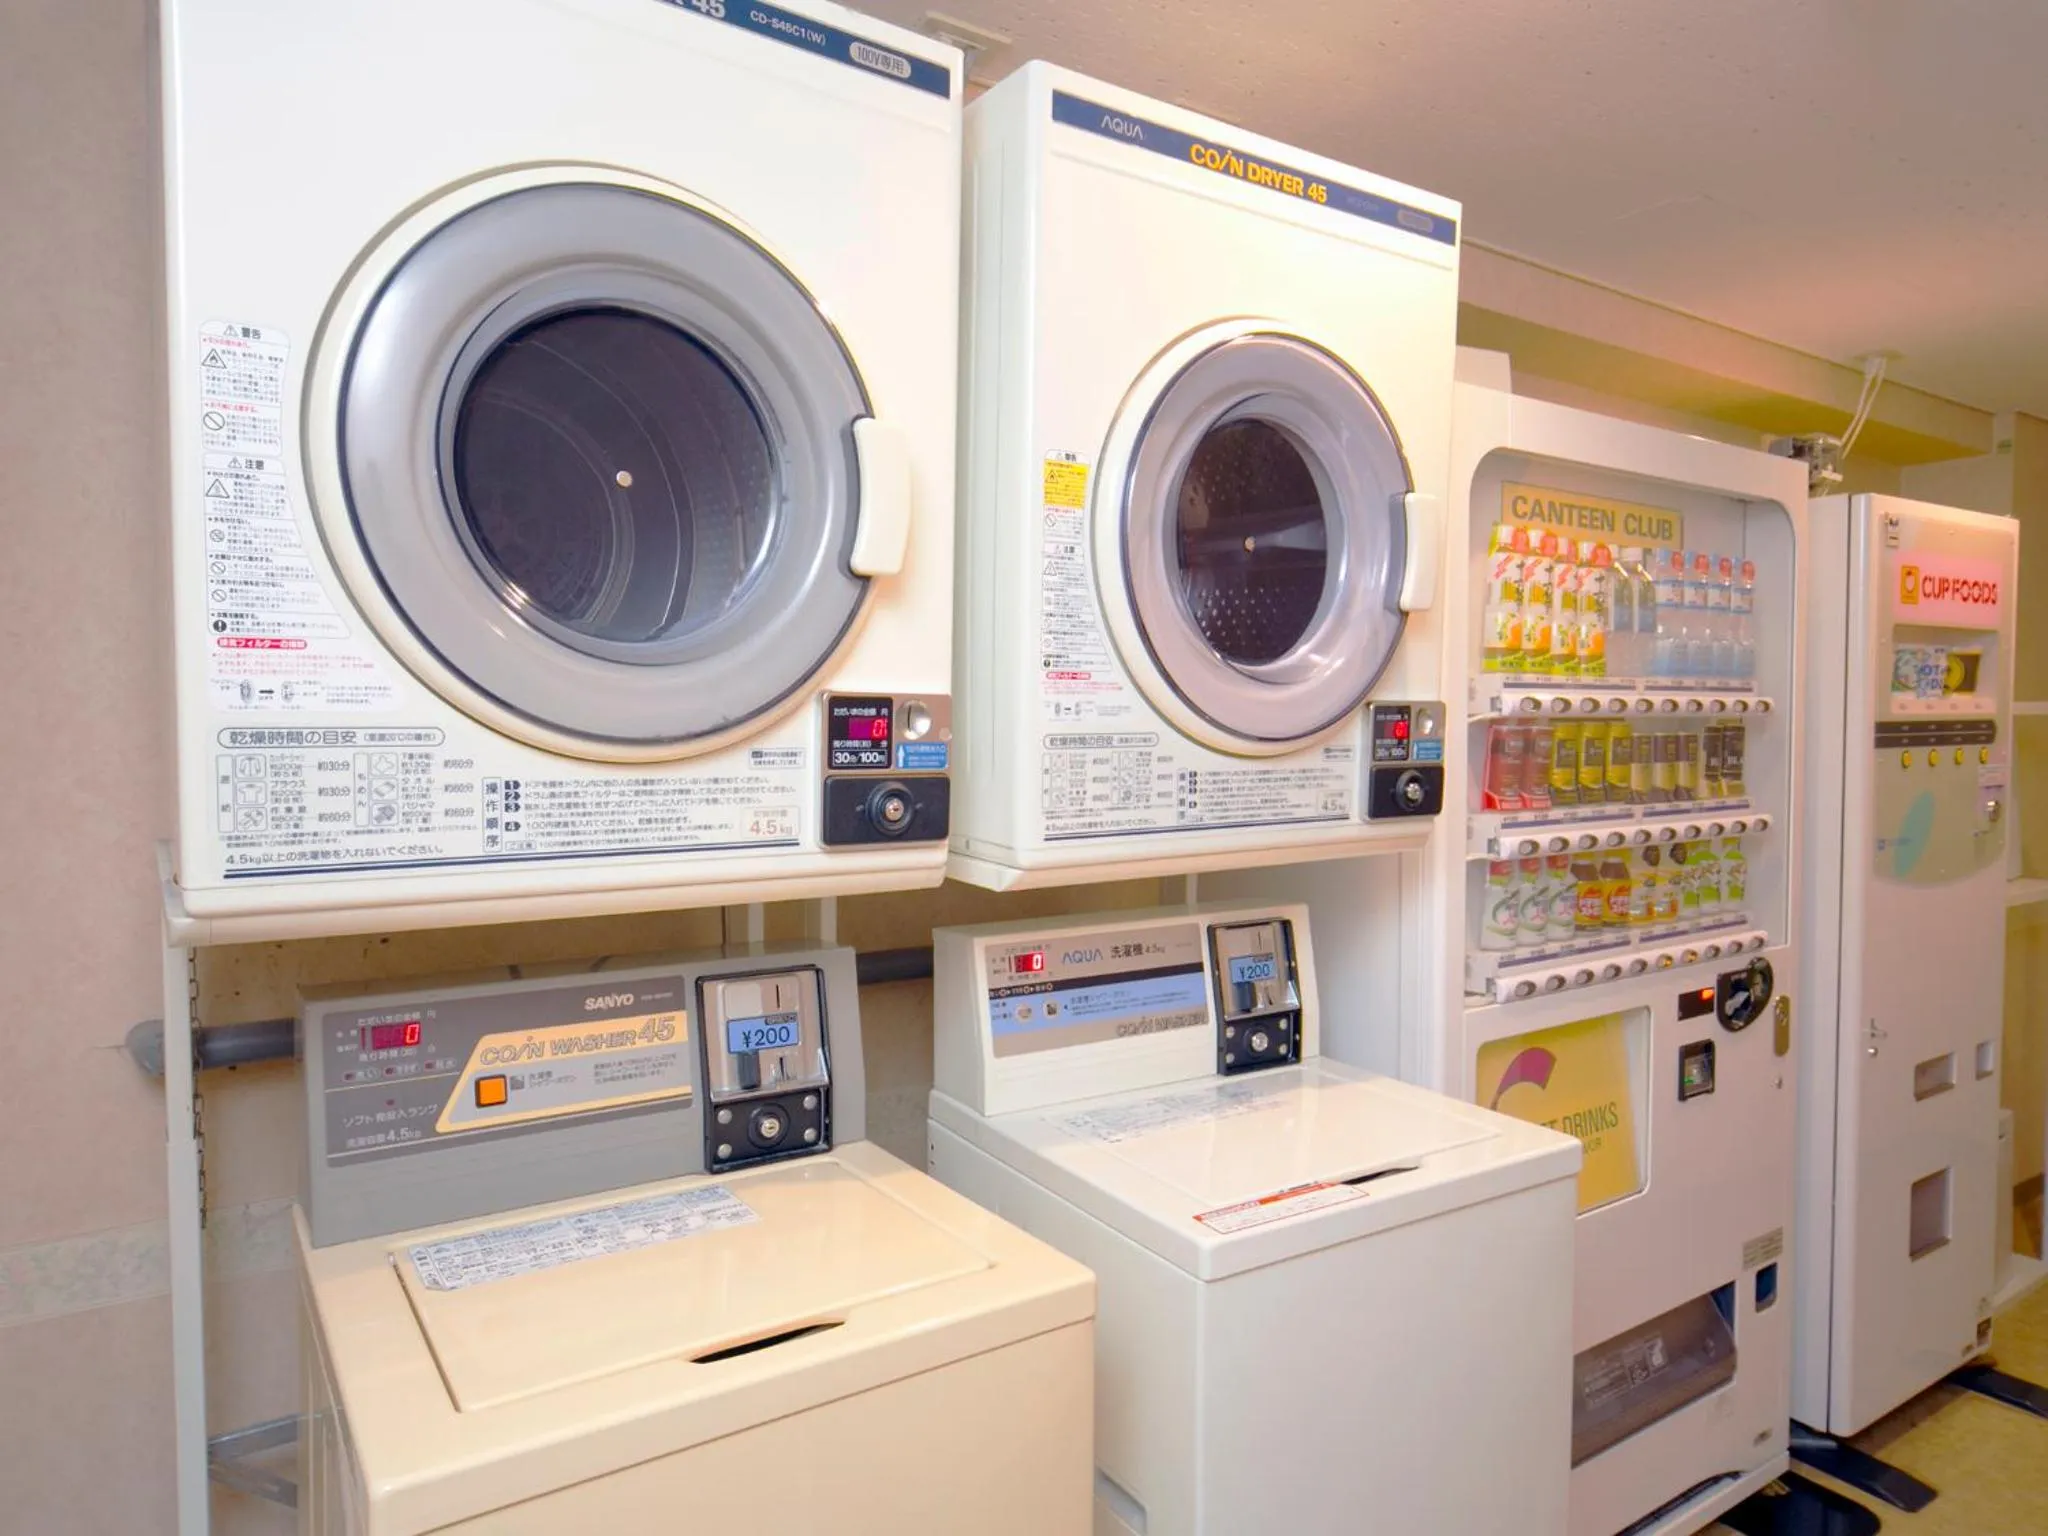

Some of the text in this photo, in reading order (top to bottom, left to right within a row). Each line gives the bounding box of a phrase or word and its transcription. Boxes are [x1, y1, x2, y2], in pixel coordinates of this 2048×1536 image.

[1101, 114, 1144, 140] AQUA
[1190, 143, 1328, 204] COIN DRYER 45
[1511, 495, 1674, 541] CANTEEN CLUB
[230, 730, 357, 745] 乾燥時間の目安
[1032, 953, 1042, 970] 0
[1062, 948, 1104, 965] AQUA
[1110, 943, 1143, 959] 洗濯機
[1239, 963, 1271, 980] ¥200
[584, 993, 634, 1011] SANYO
[405, 1023, 420, 1044] 0
[479, 1015, 676, 1066] COIN WASHER 45
[742, 1026, 790, 1048] ¥200
[1562, 1101, 1619, 1140] DRINKS
